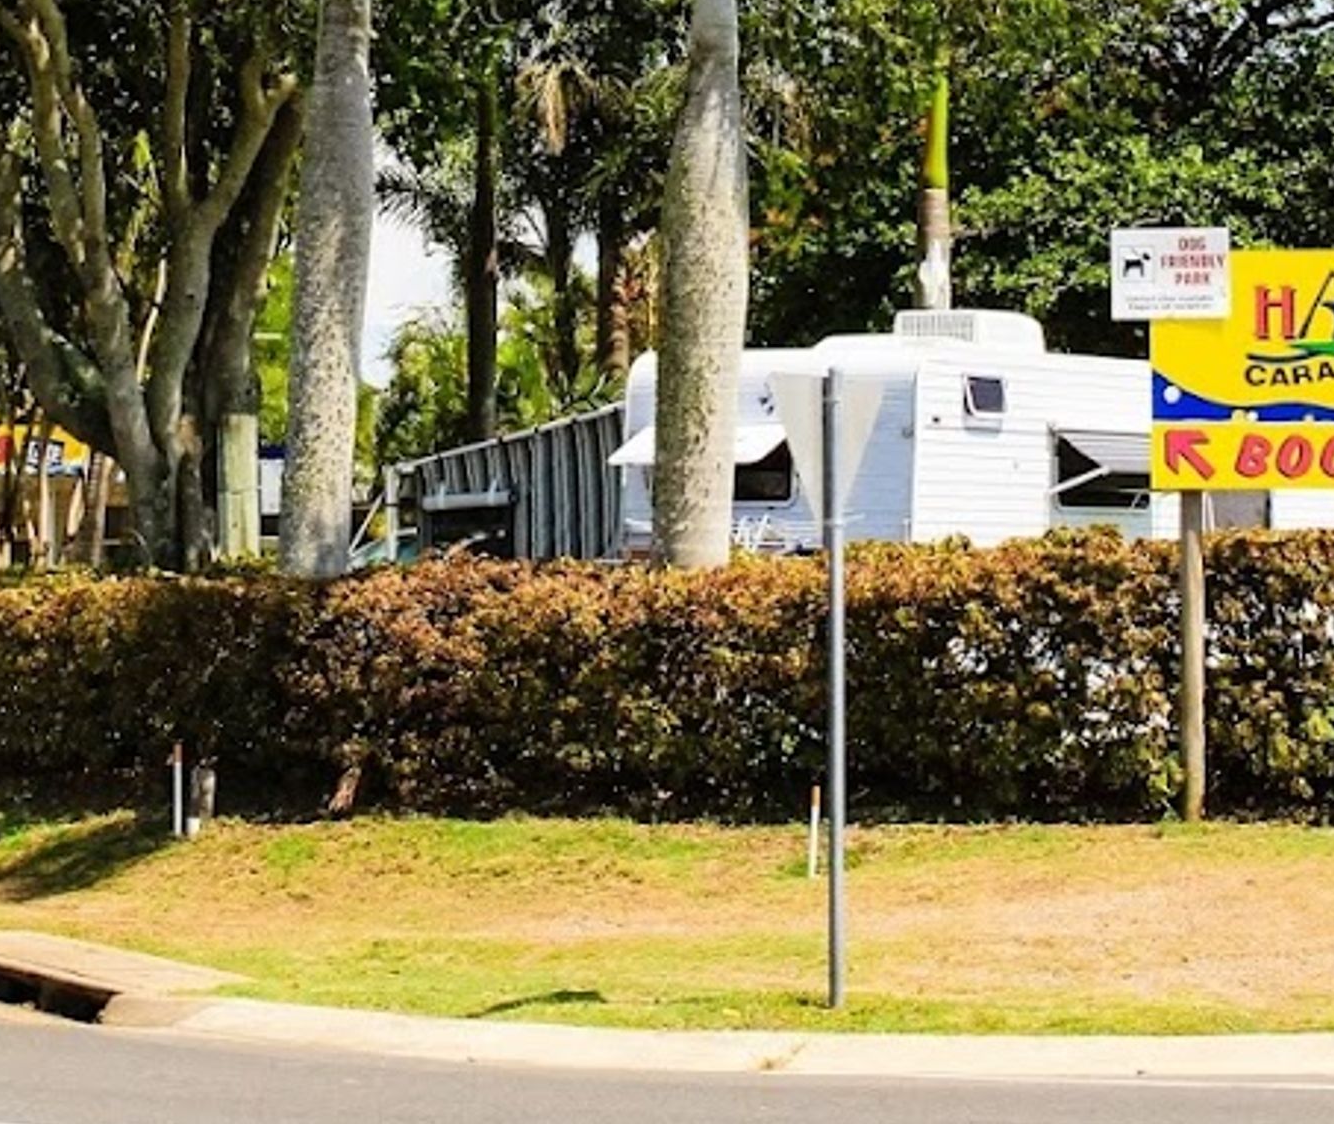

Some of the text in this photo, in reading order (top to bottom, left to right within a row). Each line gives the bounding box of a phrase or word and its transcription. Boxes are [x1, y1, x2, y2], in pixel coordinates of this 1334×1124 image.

[1178, 237, 1207, 251] DOG
[1160, 254, 1226, 268] FRIENDLY
[1175, 272, 1210, 285] PARK
